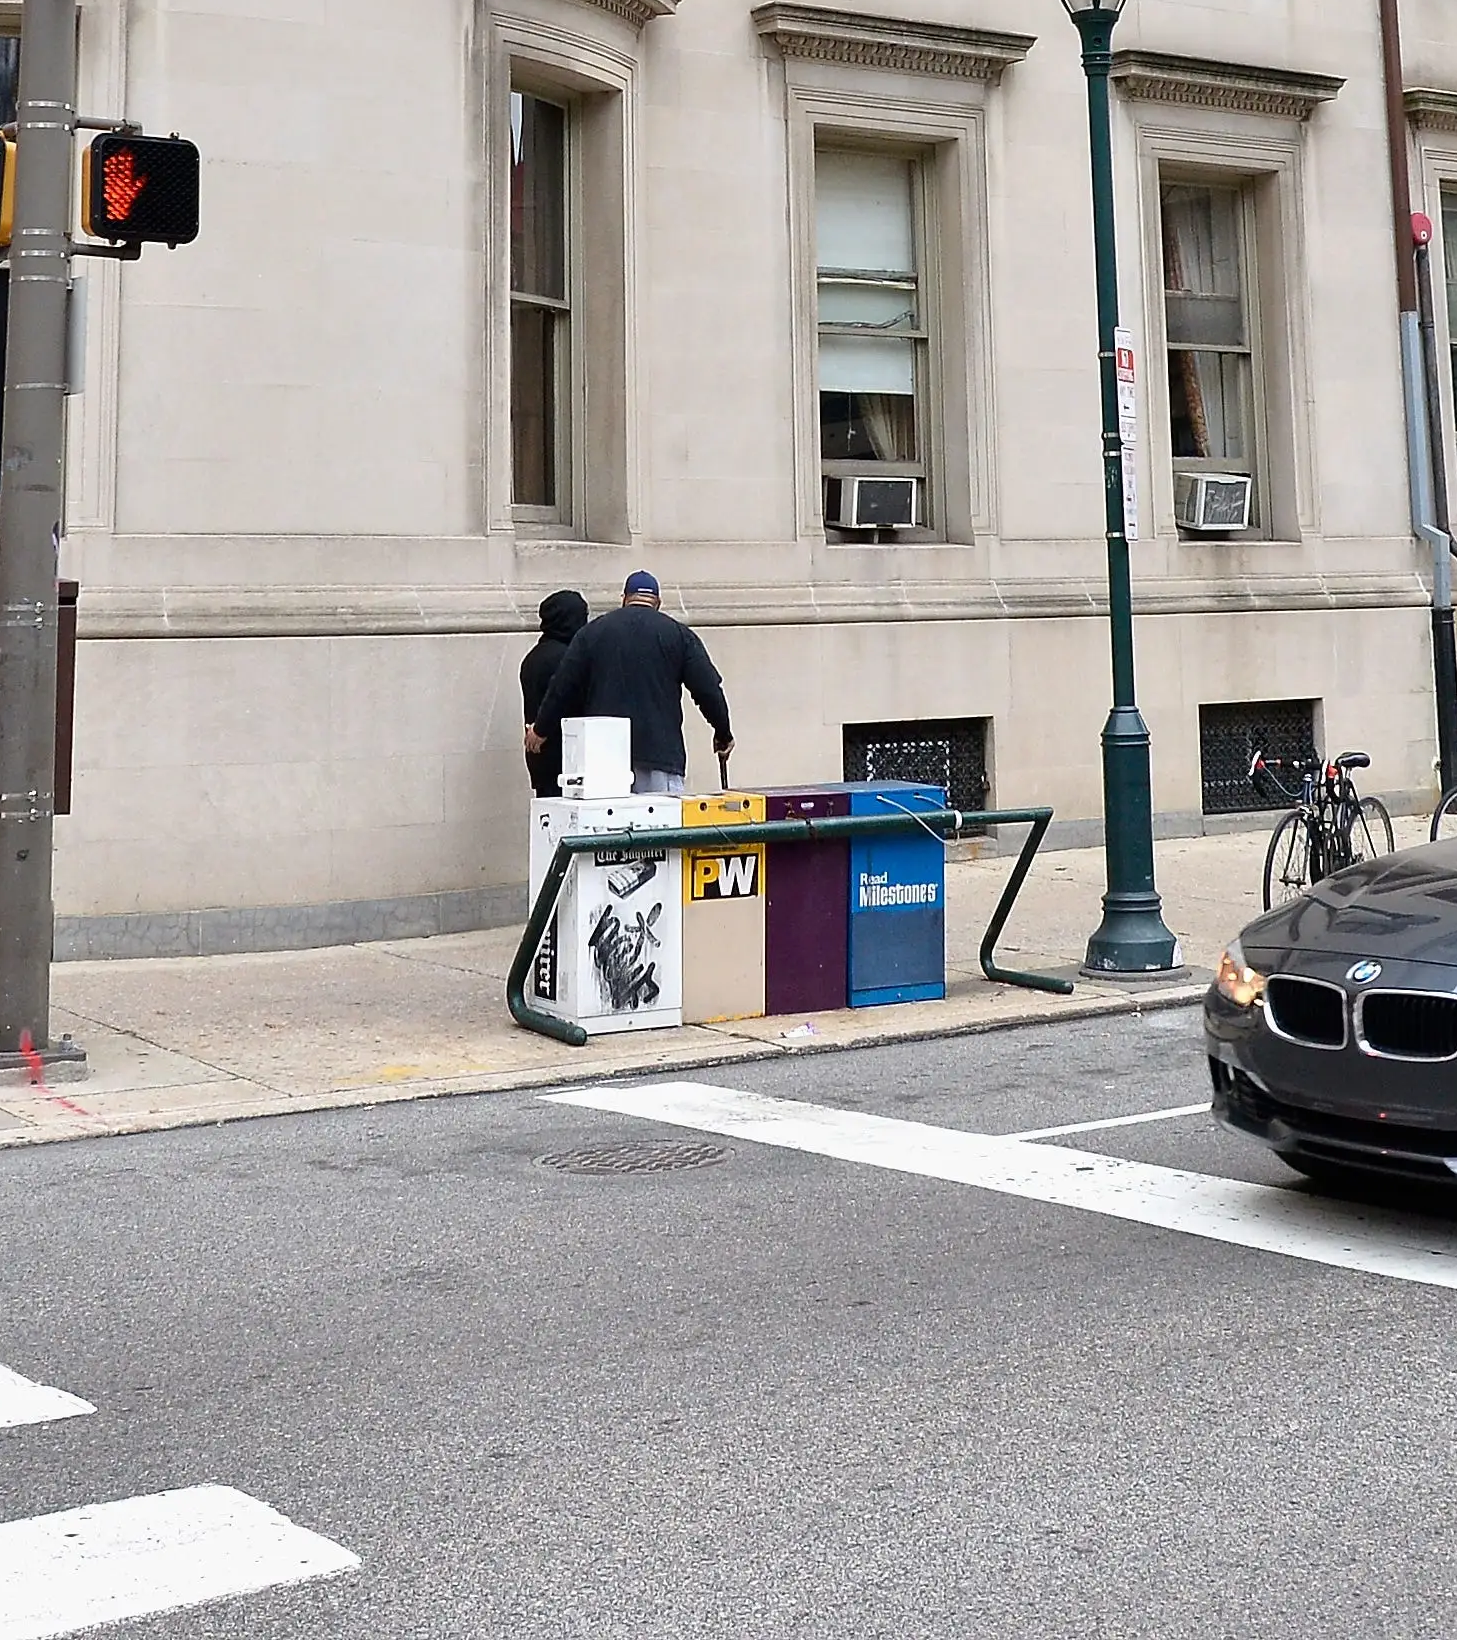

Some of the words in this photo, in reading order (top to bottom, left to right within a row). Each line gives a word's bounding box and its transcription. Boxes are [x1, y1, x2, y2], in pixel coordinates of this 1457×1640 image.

[693, 855, 757, 898] PW
[859, 872, 888, 886] Read
[859, 884, 938, 907] Milestones
